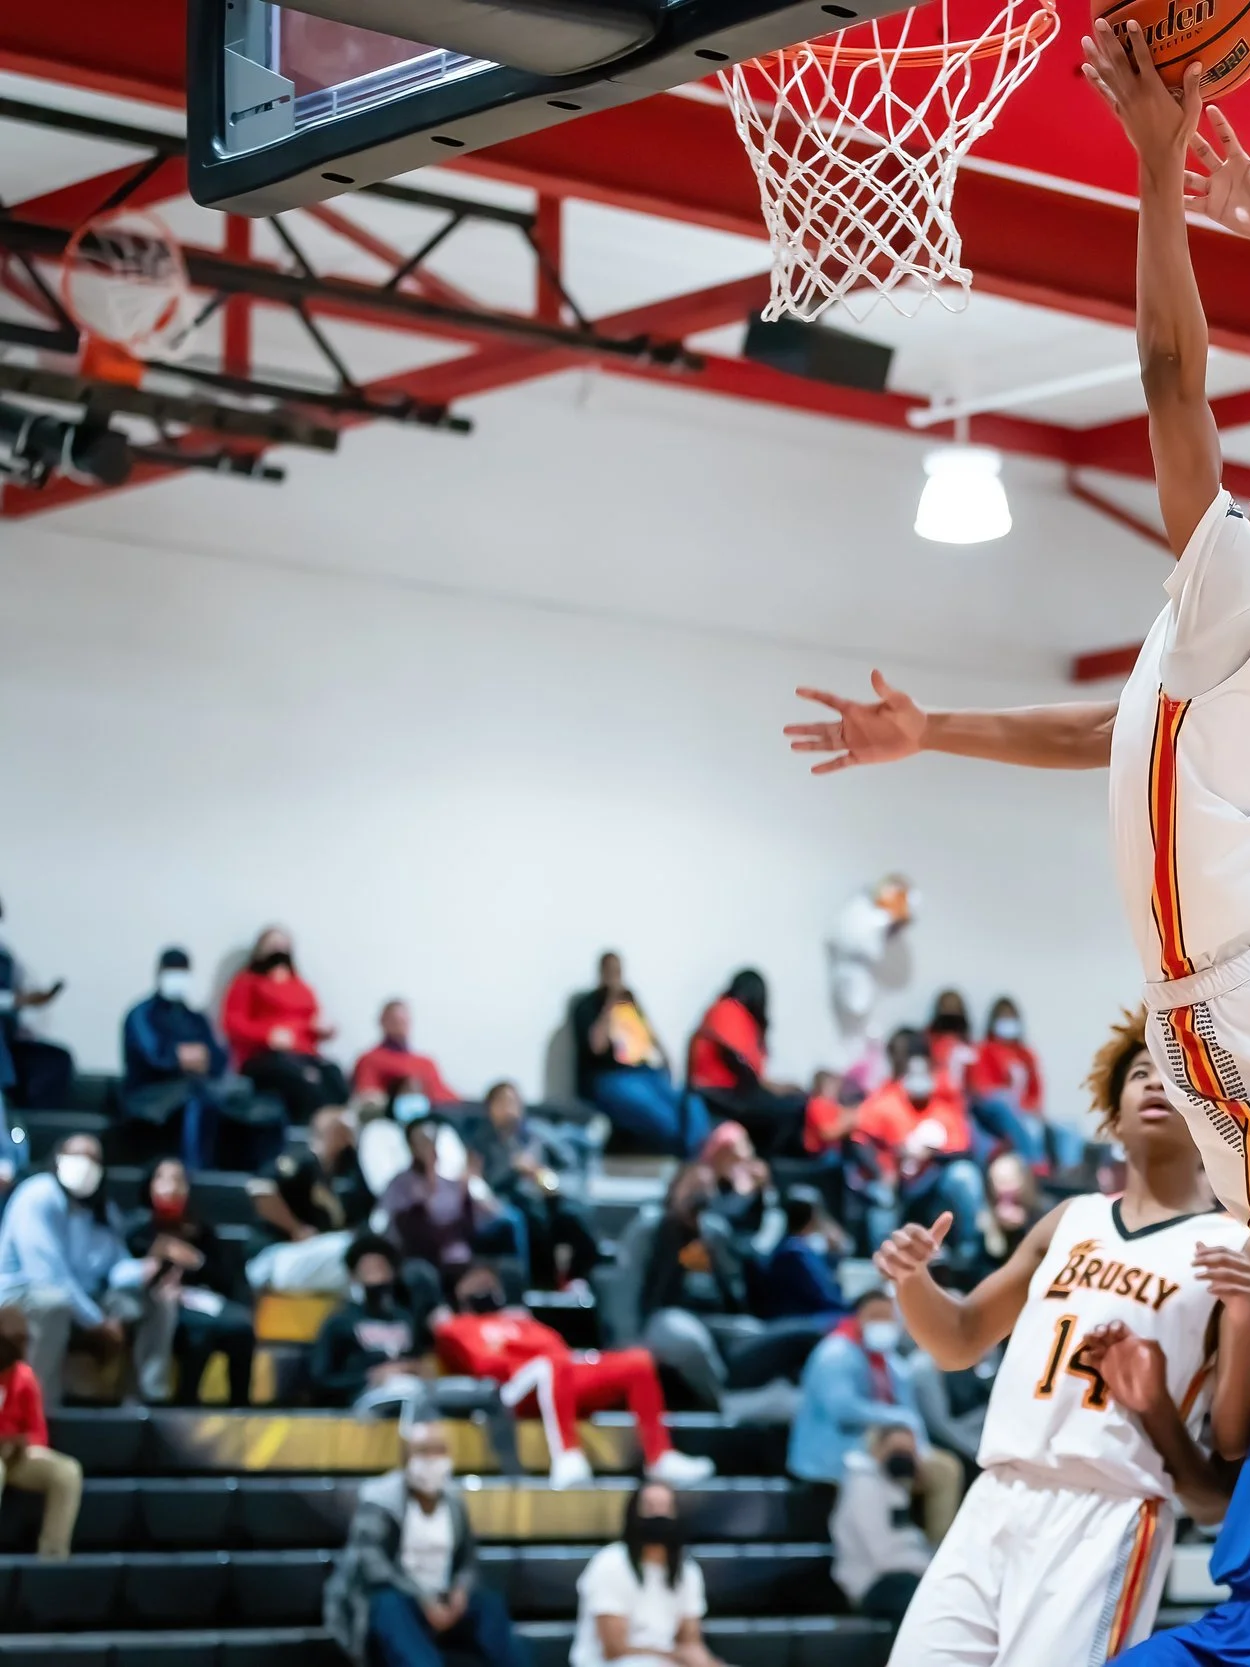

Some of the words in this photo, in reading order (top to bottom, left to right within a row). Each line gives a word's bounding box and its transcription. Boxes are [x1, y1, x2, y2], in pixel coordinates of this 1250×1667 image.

[1113, 0, 1216, 50] den
[1216, 42, 1248, 77] PRO
[1043, 1251, 1181, 1313] BRUSLY
